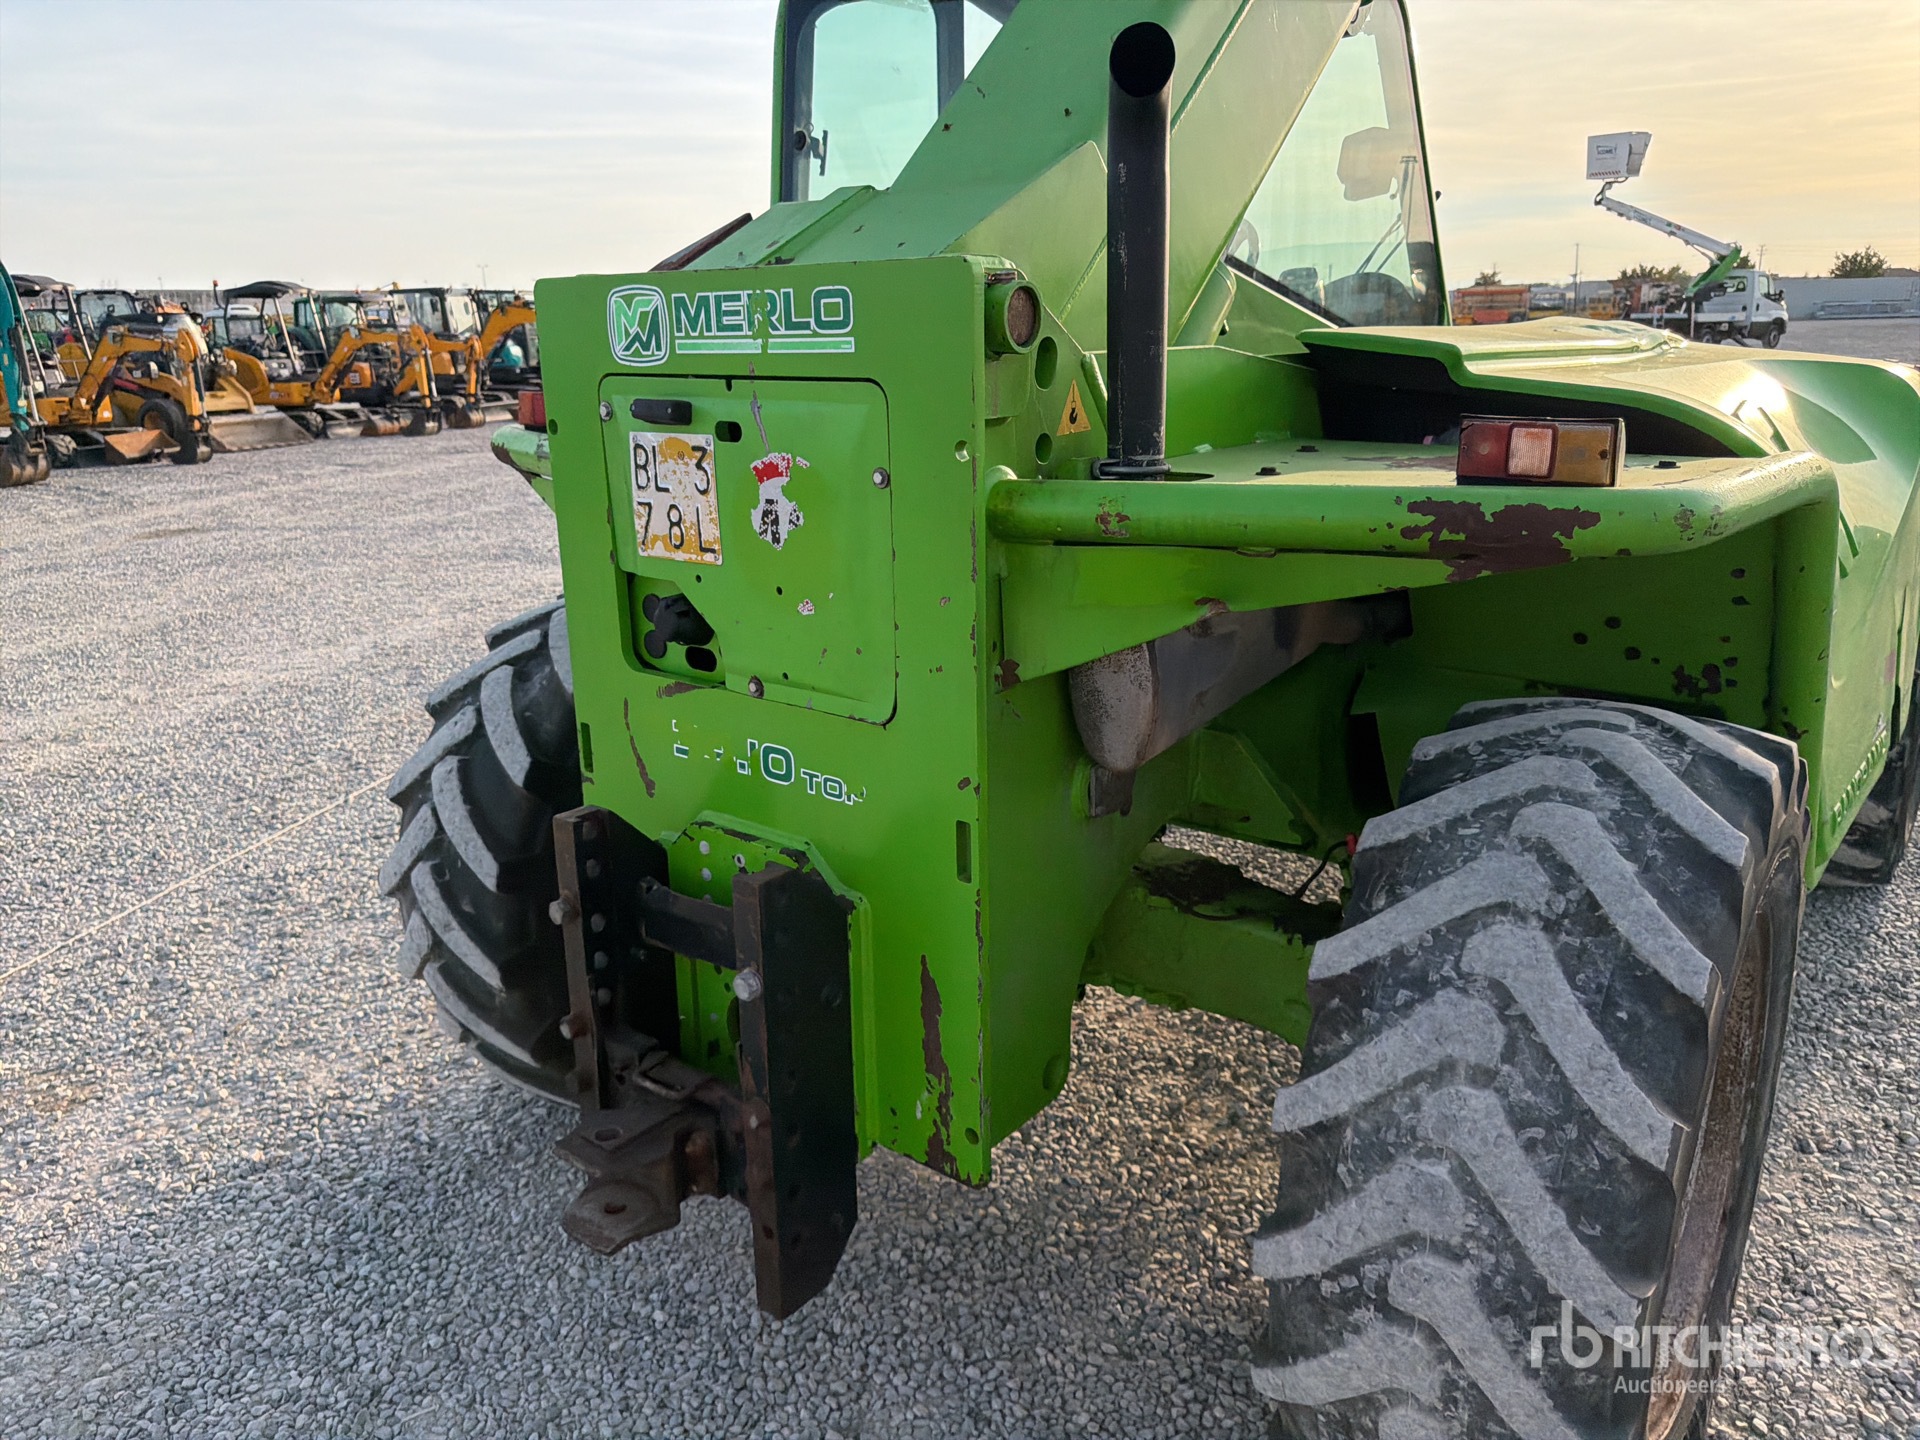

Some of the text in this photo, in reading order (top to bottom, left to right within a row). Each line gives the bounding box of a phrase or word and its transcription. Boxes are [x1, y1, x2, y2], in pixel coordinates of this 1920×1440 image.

[671, 286, 853, 336] MERLO
[633, 443, 711, 495] BL 3
